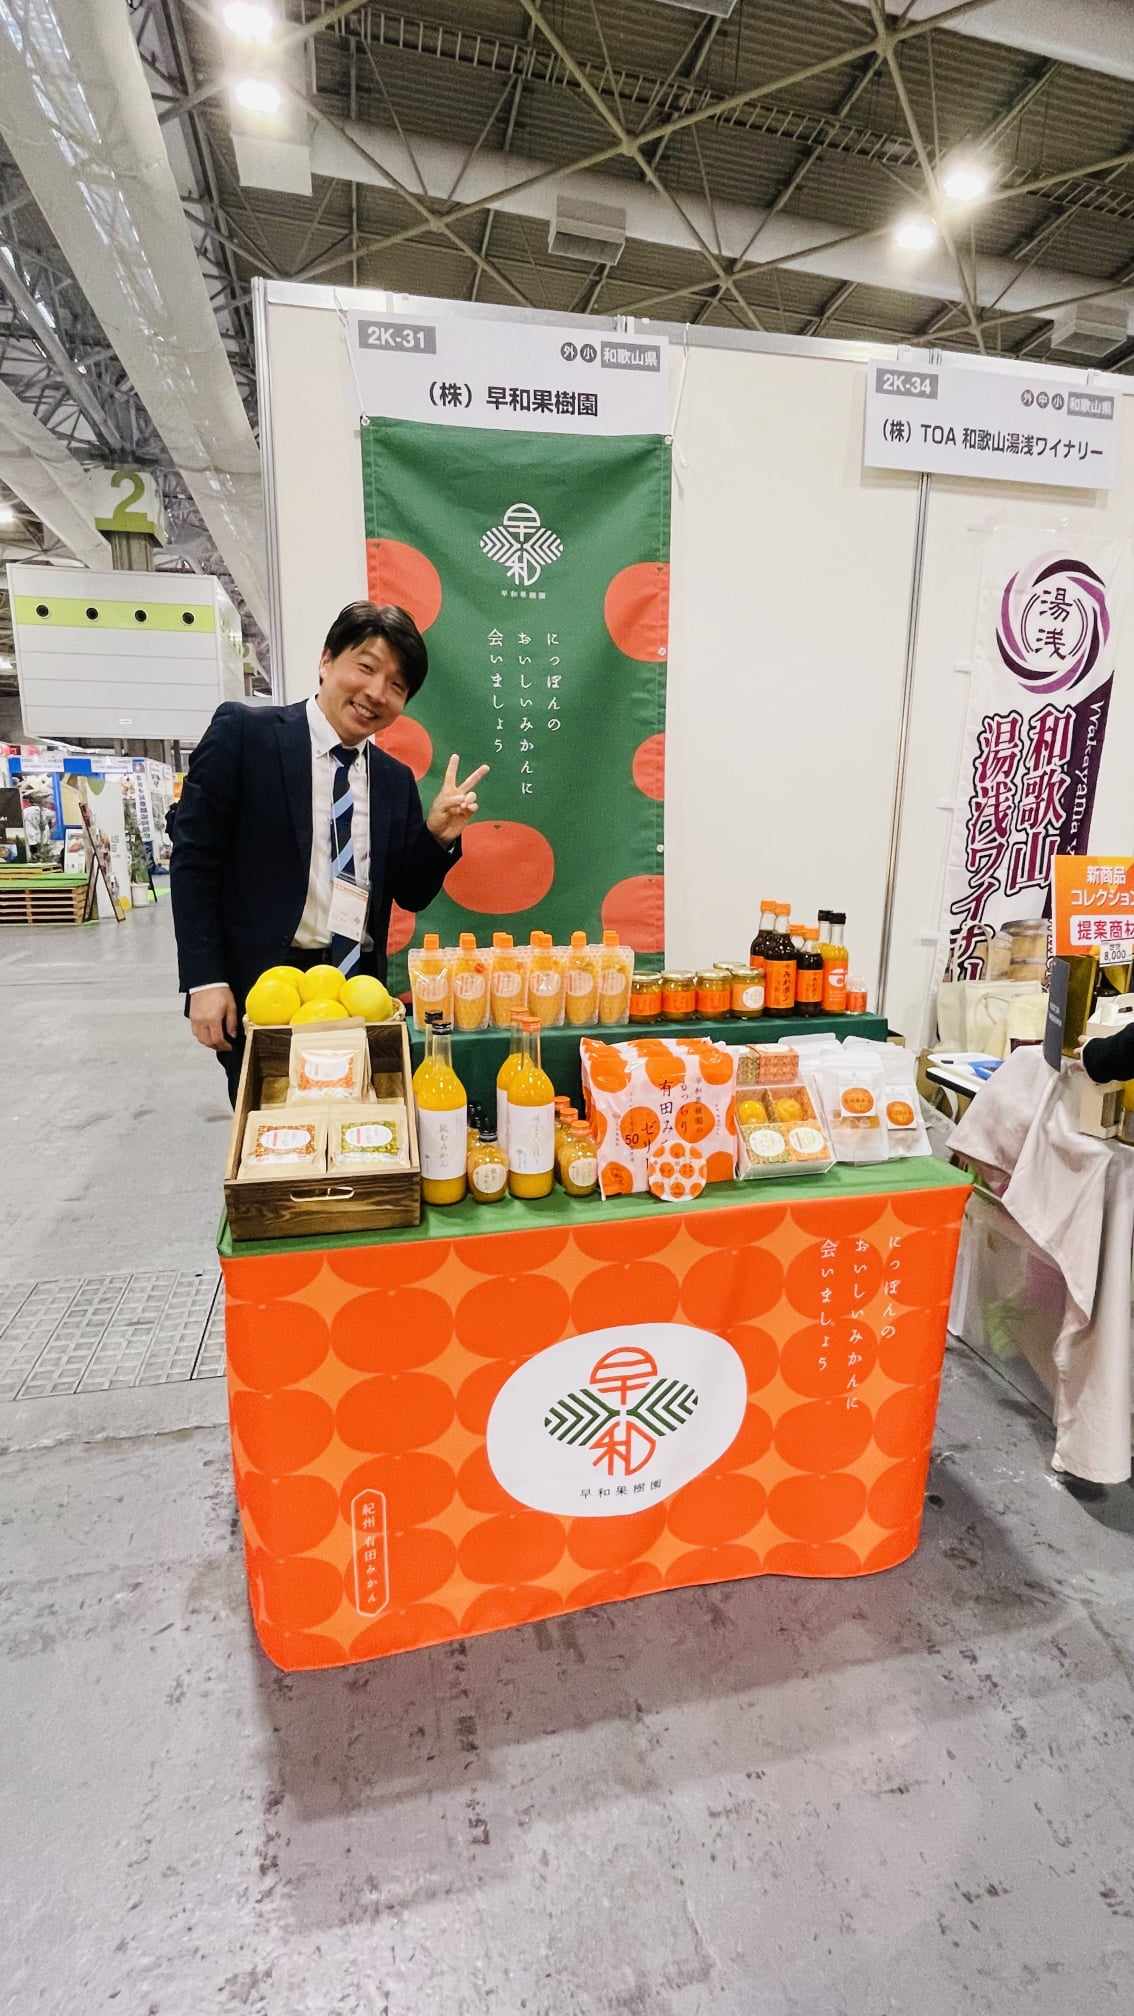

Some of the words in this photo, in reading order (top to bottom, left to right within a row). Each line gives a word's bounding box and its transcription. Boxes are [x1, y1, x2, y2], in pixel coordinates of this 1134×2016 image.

[367, 326, 425, 349] 2K-31
[562, 343, 577, 360] 外
[581, 345, 596, 362] 小
[602, 347, 657, 367] 和歌山県
[883, 373, 931, 395] 2K-34
[111, 467, 147, 521] 2
[1035, 587, 1073, 660] 湯浅
[488, 628, 504, 752] 会いましょう
[518, 632, 535, 795] おいしいみかんに
[547, 632, 562, 731] にっぽんの
[1006, 704, 1075, 896] 和歌山
[1070, 700, 1105, 834] Wakayama
[1087, 866, 1126, 885] 新商品
[624, 1132, 639, 1146] 50
[818, 1239, 839, 1372] 会いましょう
[846, 1238, 869, 1410] おいしいみかんに
[880, 1236, 902, 1339] にっぽんの
